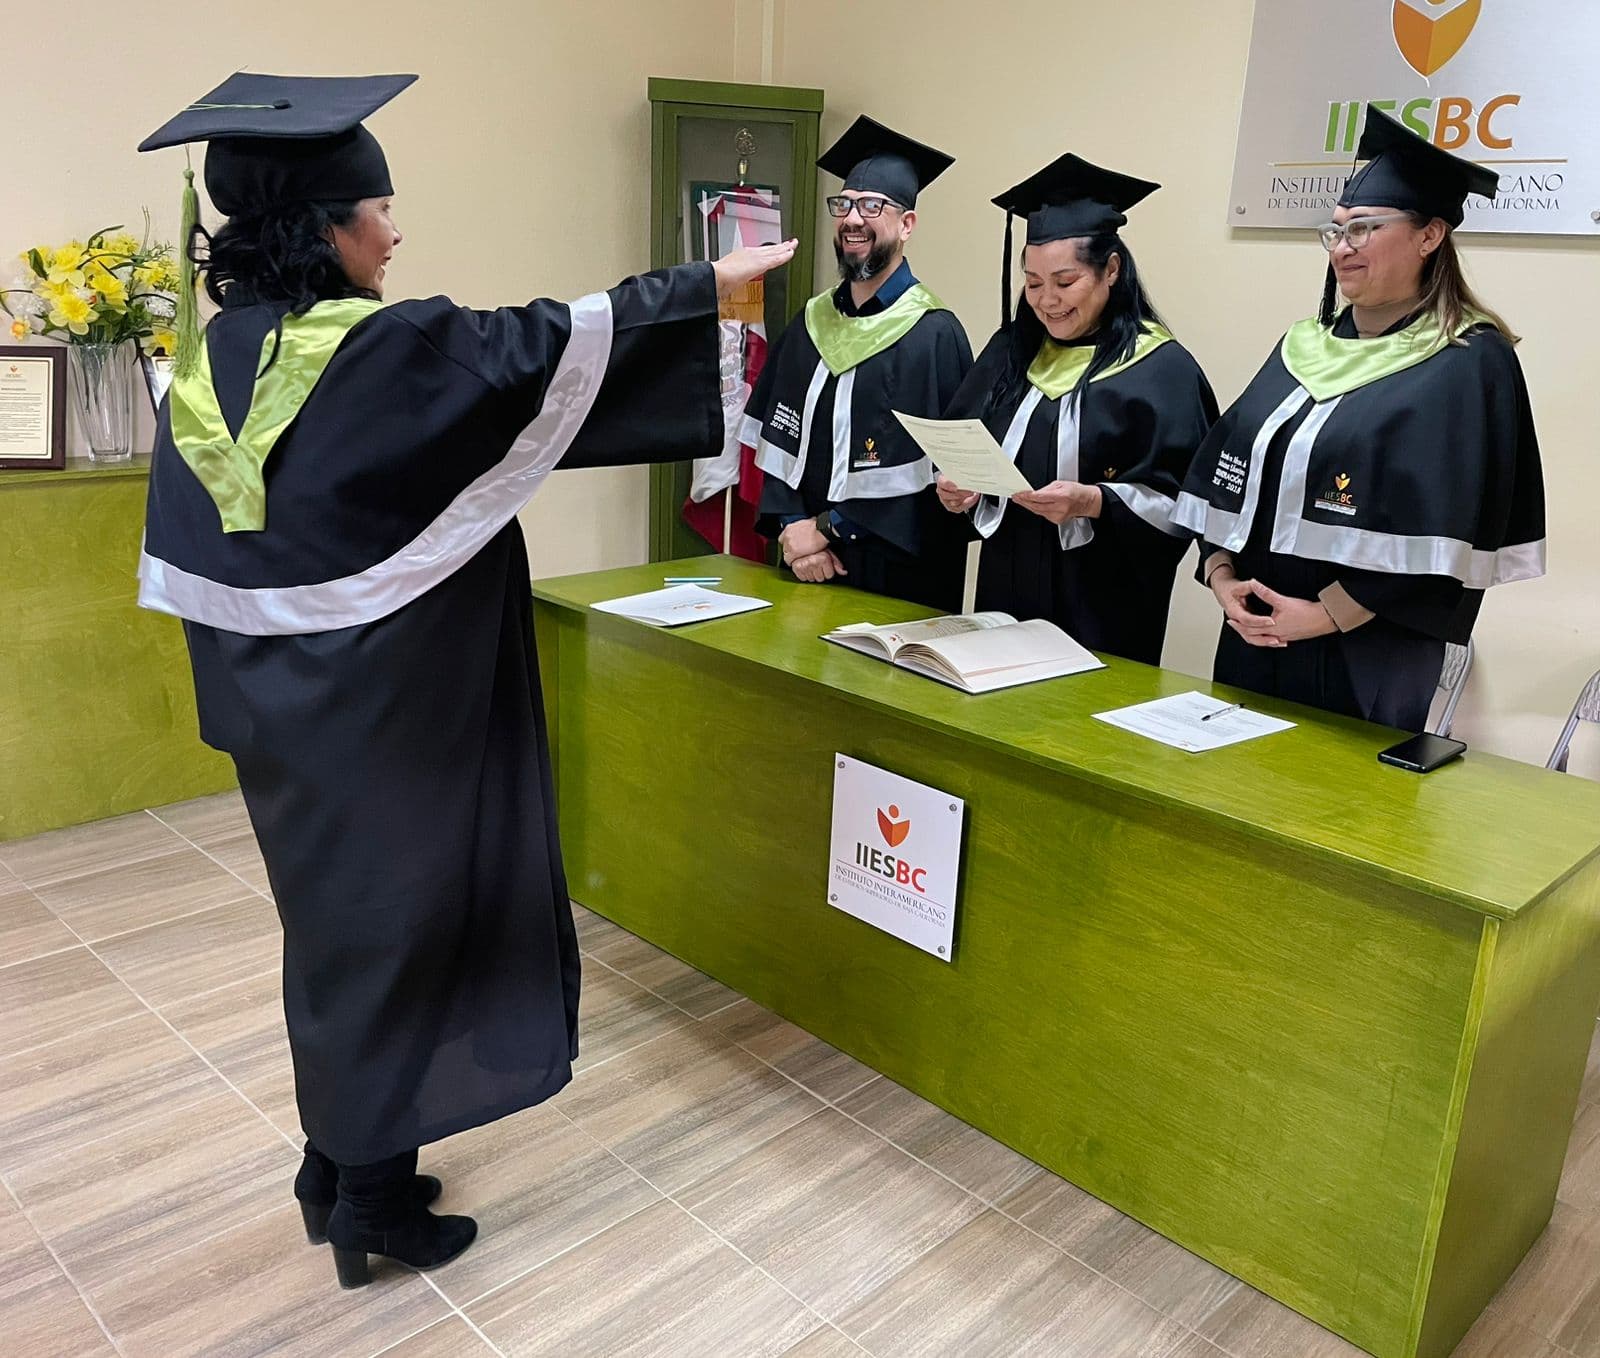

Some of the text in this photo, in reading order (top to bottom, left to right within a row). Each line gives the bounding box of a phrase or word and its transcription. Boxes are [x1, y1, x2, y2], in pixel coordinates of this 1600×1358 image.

[1324, 94, 1521, 152] IISBC
[1271, 176, 1349, 193] INSTITU
[1286, 198, 1337, 209] ESTUDIO
[835, 864, 946, 921] INSTITUTO INTERAMERICANO
[855, 842, 927, 893] IIESBC
